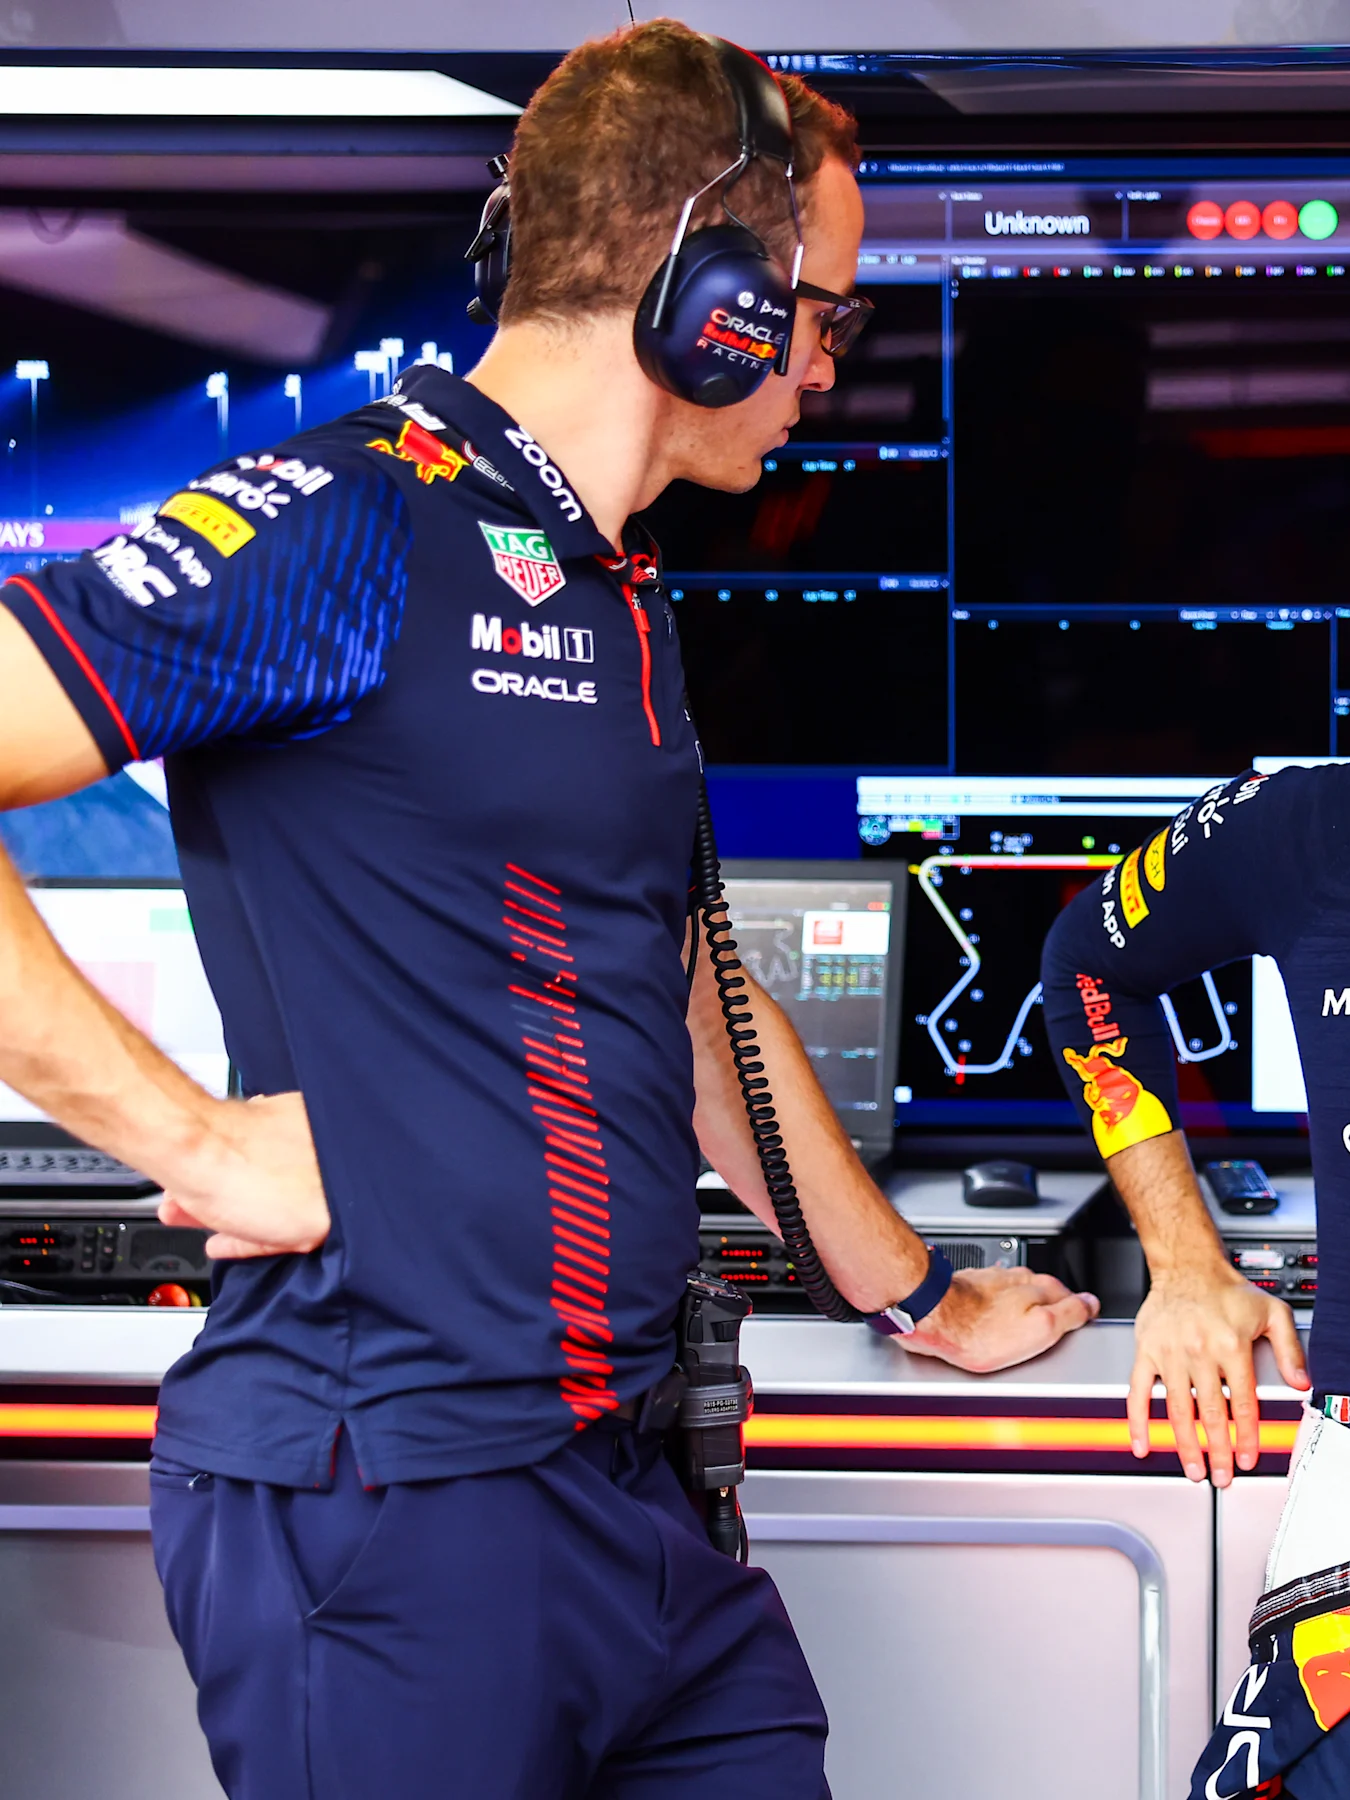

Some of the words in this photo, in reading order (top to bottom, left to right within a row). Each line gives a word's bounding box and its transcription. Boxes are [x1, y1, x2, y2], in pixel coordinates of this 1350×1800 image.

[984, 210, 1091, 236] Unknown
[710, 308, 785, 345] ORACLE
[772, 307, 789, 319] poly
[703, 322, 728, 344] Red
[696, 338, 770, 372] RACING
[504, 425, 583, 522] zoom
[0, 521, 45, 548] AYS
[487, 529, 549, 559] TAG
[499, 554, 560, 598] HEUER
[472, 613, 561, 661] Mobil
[471, 668, 598, 705] ORACLE
